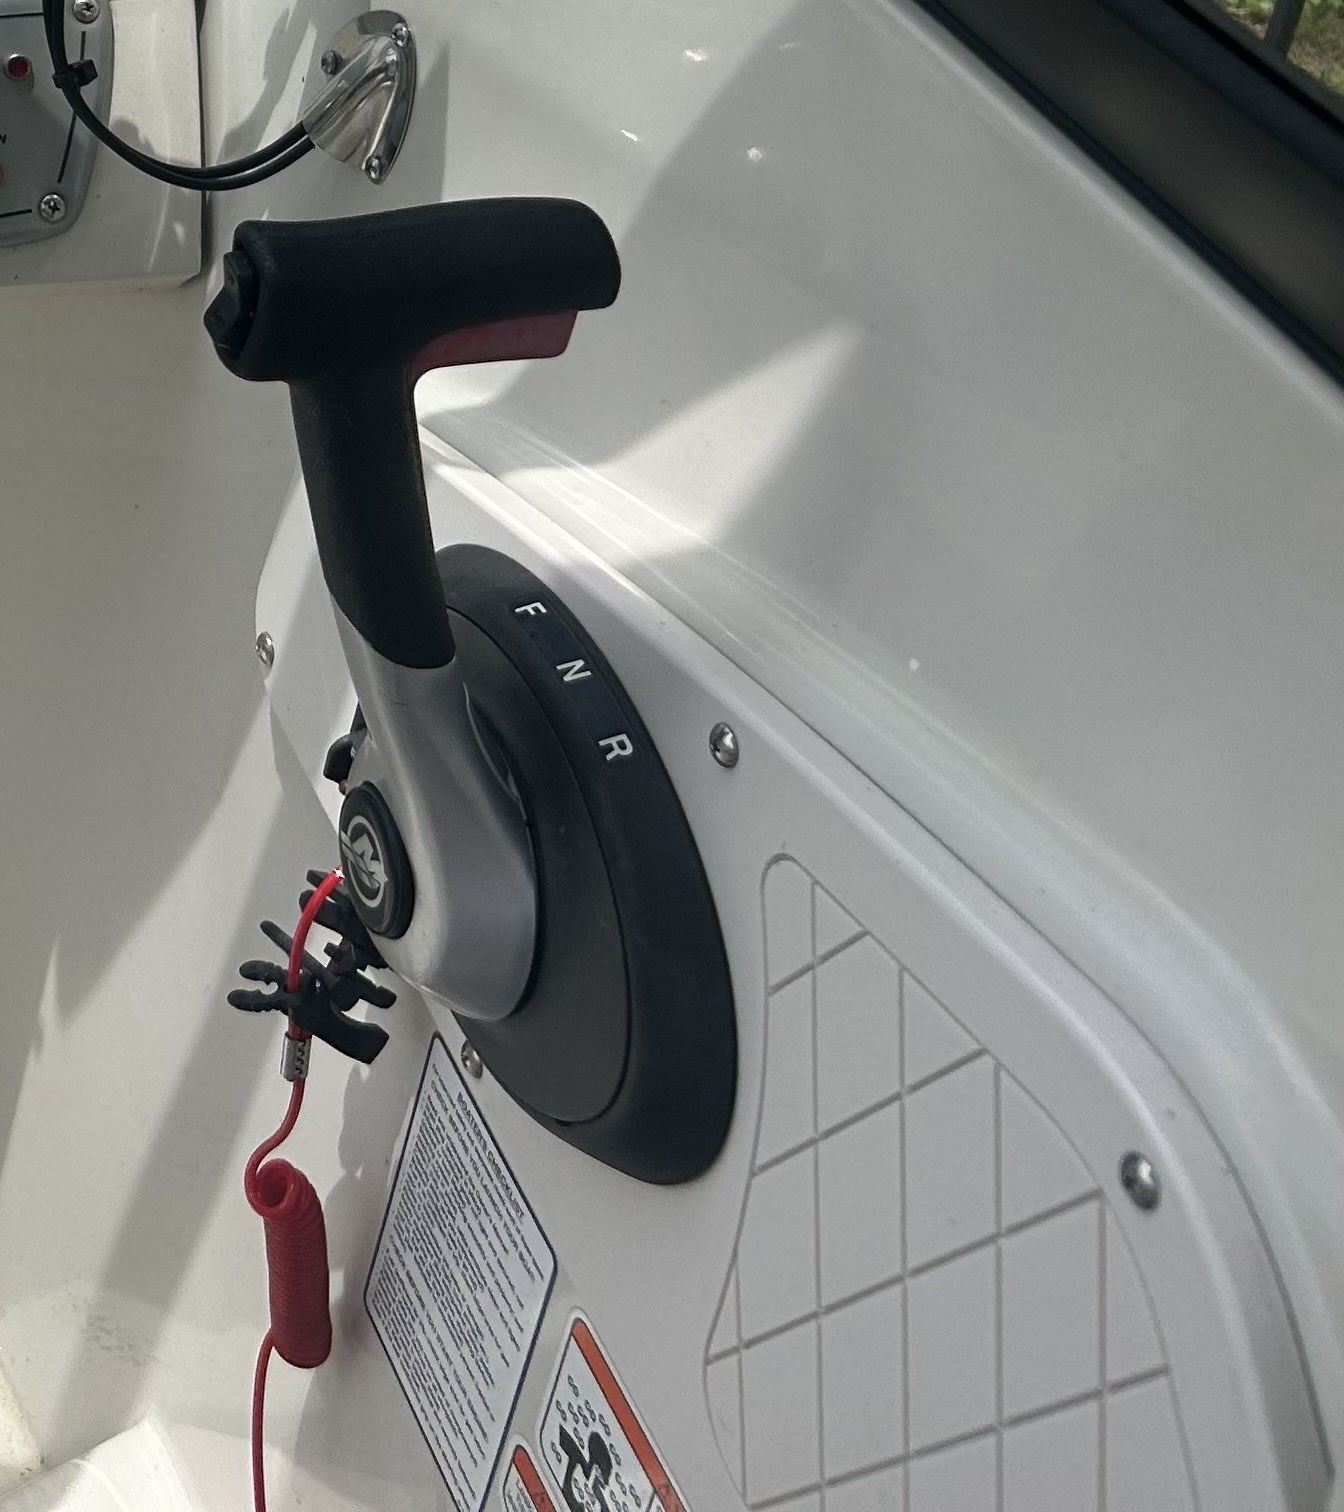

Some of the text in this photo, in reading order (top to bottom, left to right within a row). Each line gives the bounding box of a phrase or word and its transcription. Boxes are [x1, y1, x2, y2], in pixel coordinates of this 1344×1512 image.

[514, 601, 548, 617] F
[556, 659, 591, 682] N
[598, 732, 634, 761] R
